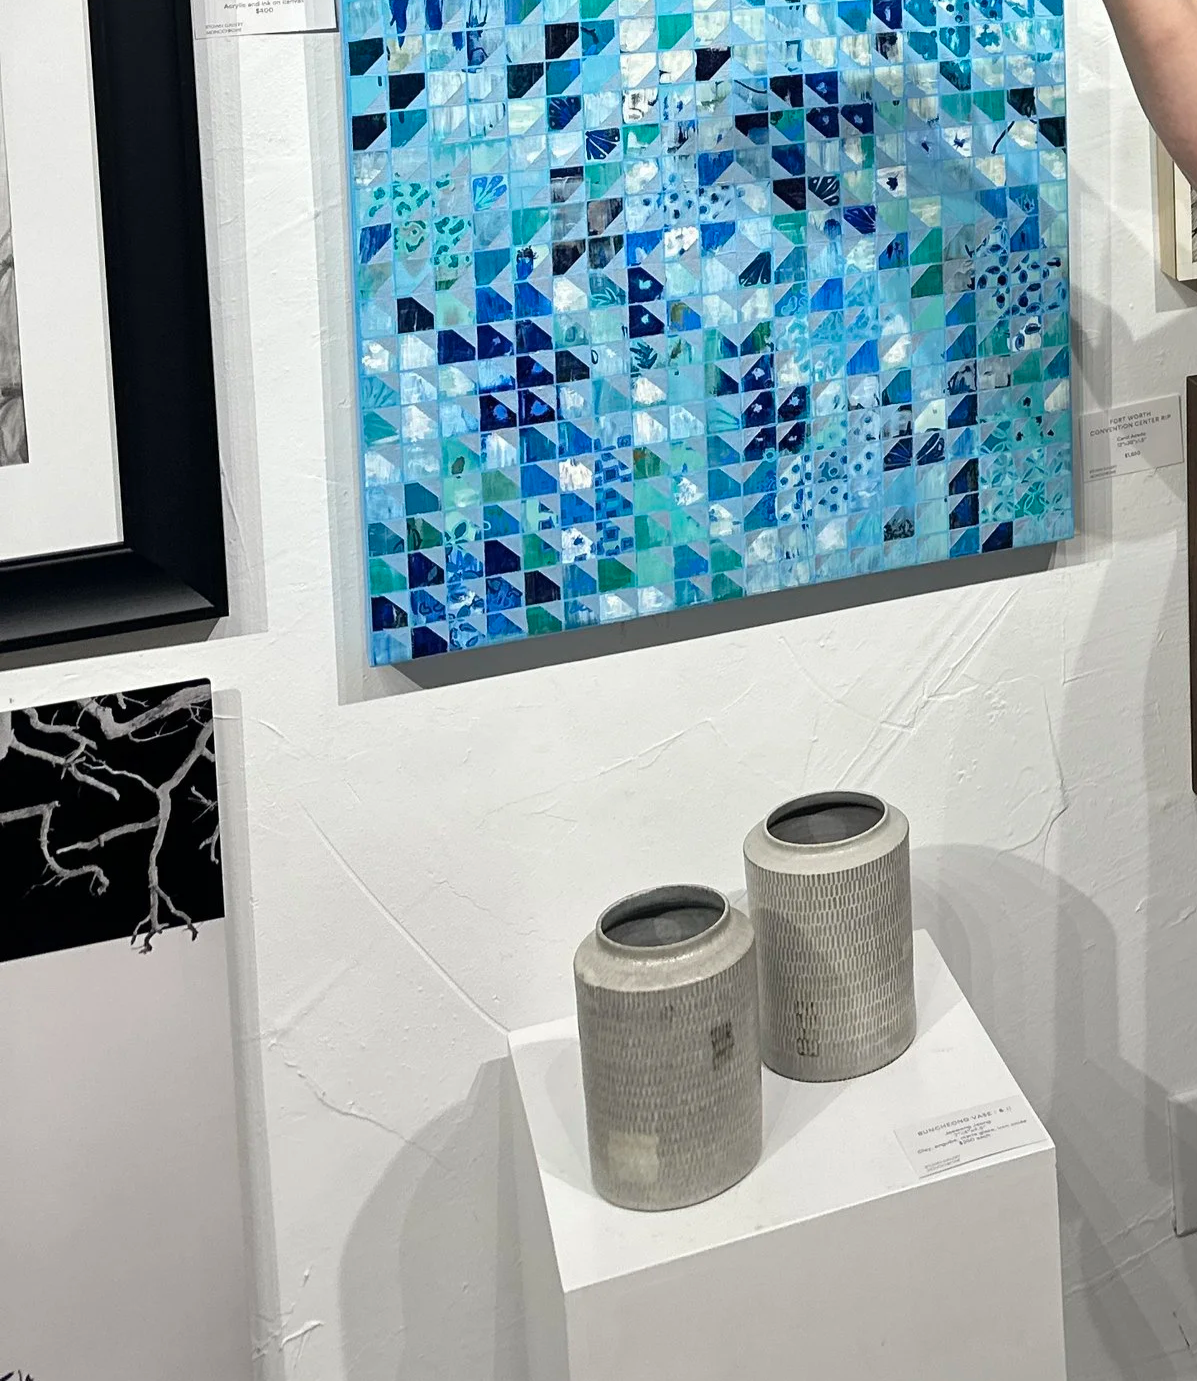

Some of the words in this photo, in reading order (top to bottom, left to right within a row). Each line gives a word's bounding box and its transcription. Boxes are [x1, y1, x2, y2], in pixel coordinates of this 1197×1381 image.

[1089, 422, 1134, 437] CONVENTION
[1134, 415, 1160, 427] CENTER
[1109, 416, 1126, 425] FORT
[1127, 411, 1152, 422] WORTH
[917, 1116, 970, 1136] BUNCHEONG
[971, 1111, 992, 1121] VASE
